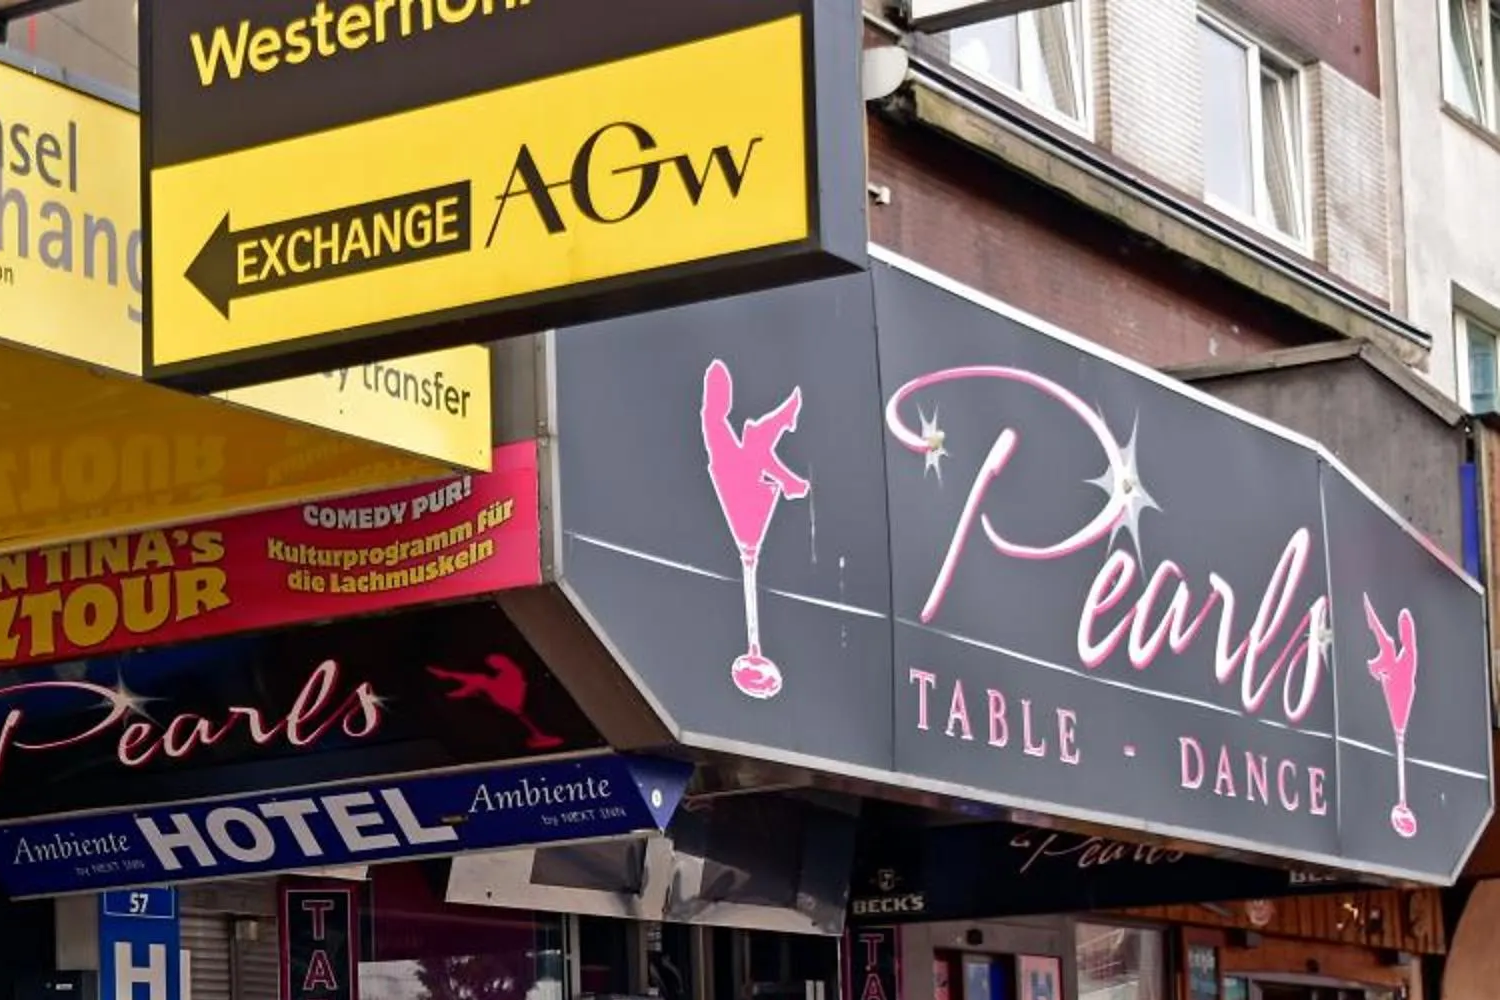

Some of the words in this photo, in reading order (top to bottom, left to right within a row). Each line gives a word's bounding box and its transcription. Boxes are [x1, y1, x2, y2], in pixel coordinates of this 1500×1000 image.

[190, 0, 531, 86] Western
[236, 196, 460, 285] EXCHANGE
[362, 361, 471, 418] transfer
[303, 505, 407, 530] COMEDY
[412, 476, 472, 520] PUR!
[37, 529, 225, 585] TINA'S
[267, 520, 473, 571] Kulturprogramm
[476, 498, 514, 534] für
[886, 365, 1333, 722] Pearls
[288, 569, 325, 593] die
[909, 668, 1083, 766] TABLE
[1179, 735, 1330, 818] DANCE
[468, 776, 612, 814] Ambiente
[12, 830, 132, 866] Ambiente
[134, 787, 460, 872] HOTEL
[128, 891, 149, 914] 57
[852, 893, 925, 915] BECK'S
